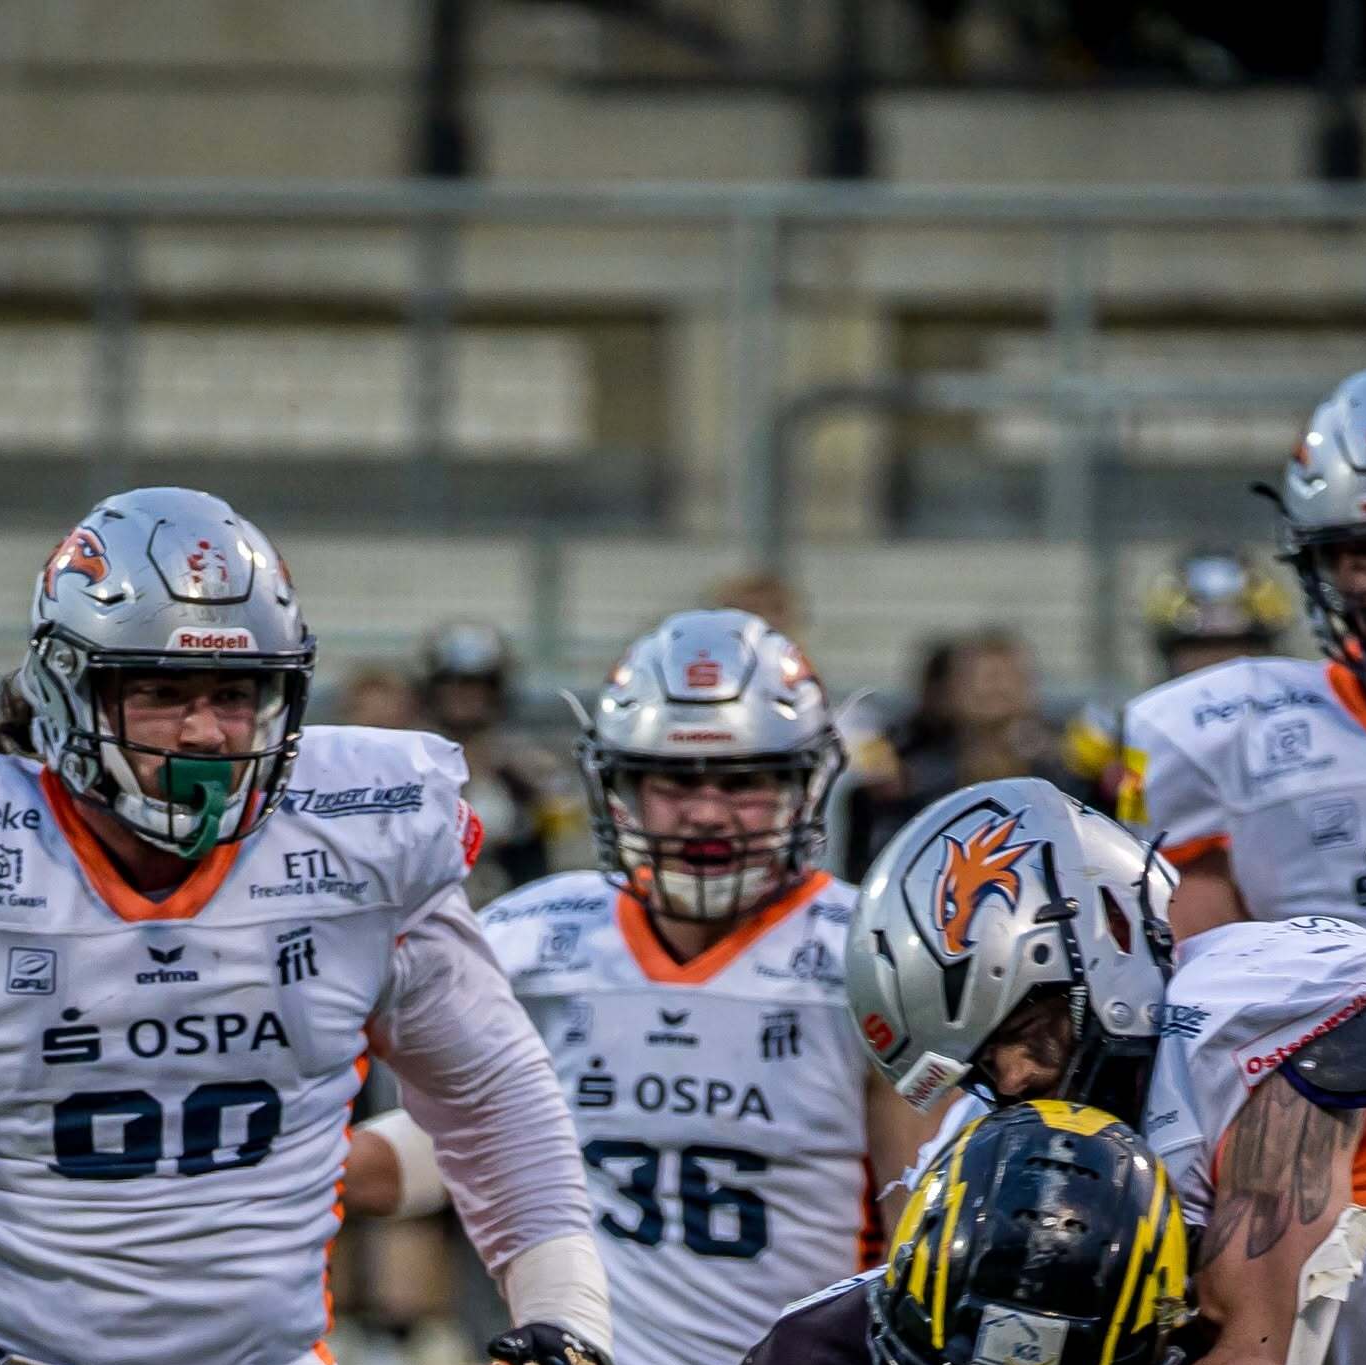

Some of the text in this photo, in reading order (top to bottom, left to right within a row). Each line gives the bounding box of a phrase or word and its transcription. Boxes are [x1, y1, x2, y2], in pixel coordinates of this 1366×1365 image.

[179, 634, 249, 649] Riddell
[284, 849, 337, 879] ETL
[136, 969, 200, 985] erima
[275, 939, 320, 986] fit
[127, 1012, 291, 1058] OSPA
[636, 1074, 774, 1124] OSPA
[582, 1140, 768, 1258] 36
